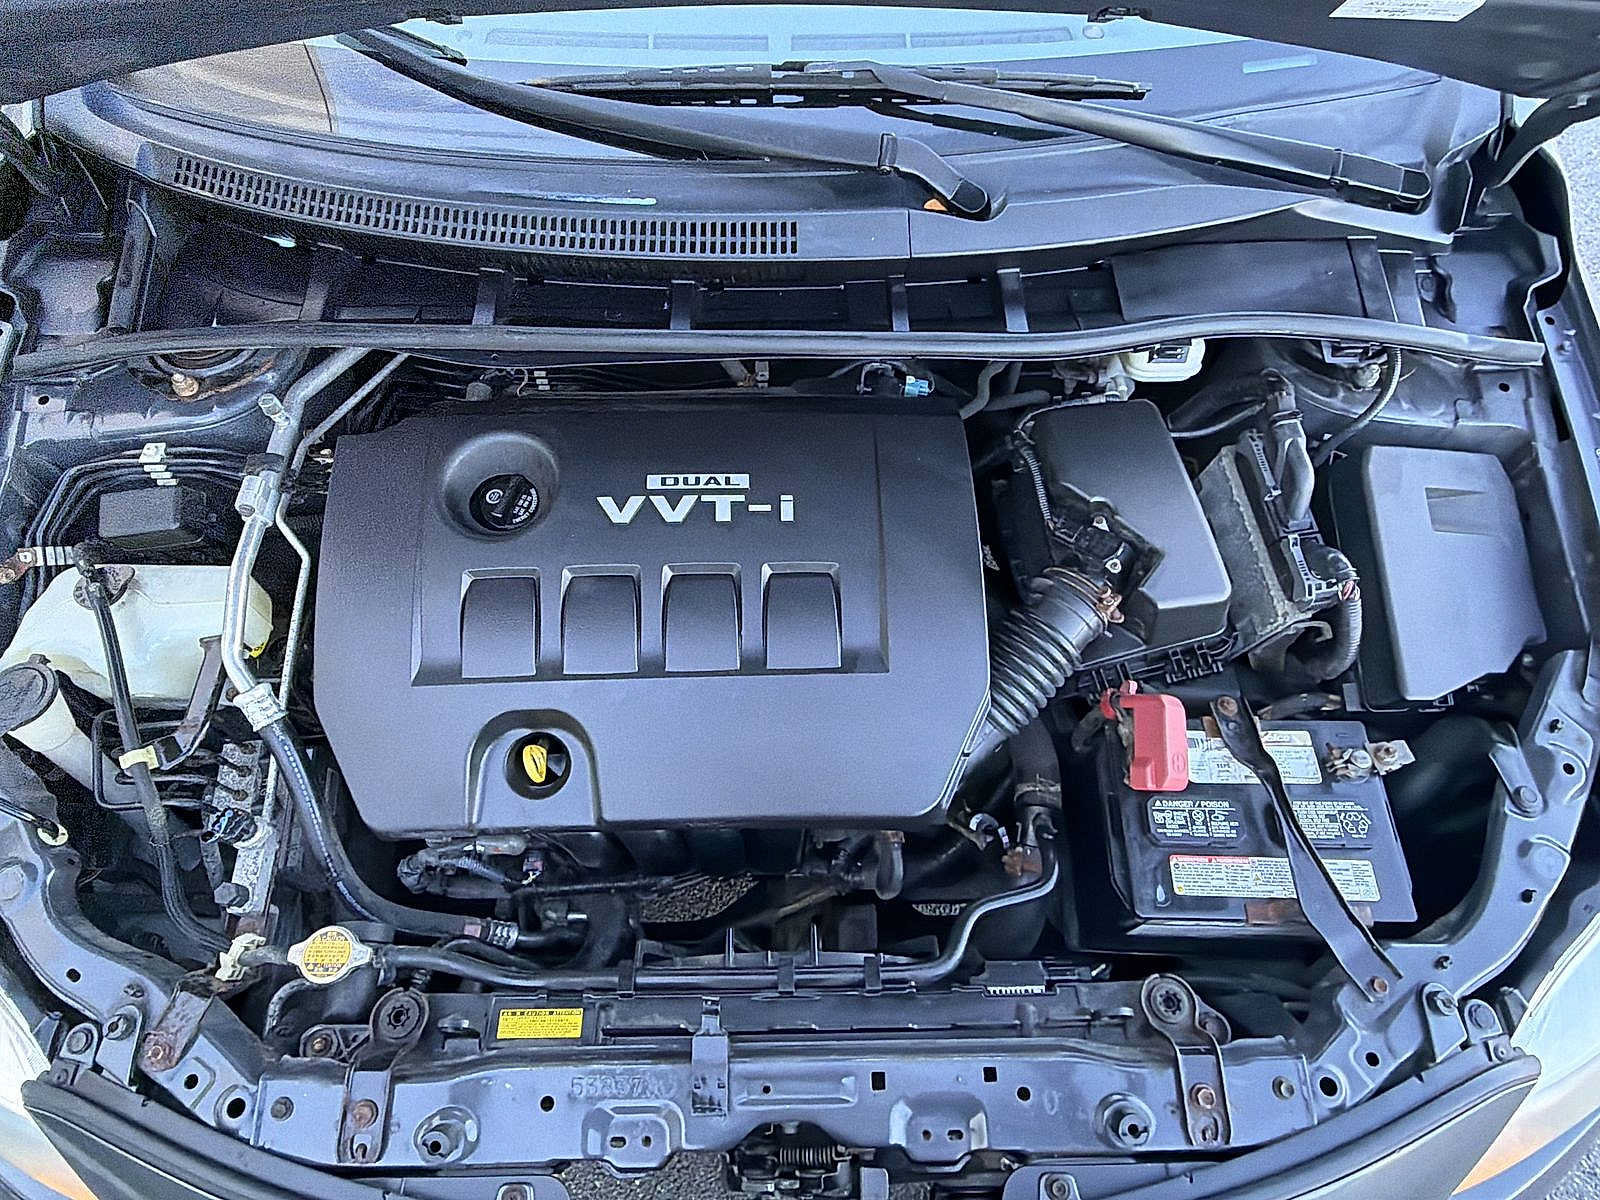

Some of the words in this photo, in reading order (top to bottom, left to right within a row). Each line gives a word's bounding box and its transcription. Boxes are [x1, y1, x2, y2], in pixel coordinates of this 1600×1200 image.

[660, 476, 740, 487] DUAL
[596, 494, 795, 524] VVT-i
[1162, 800, 1193, 808] DANGER
